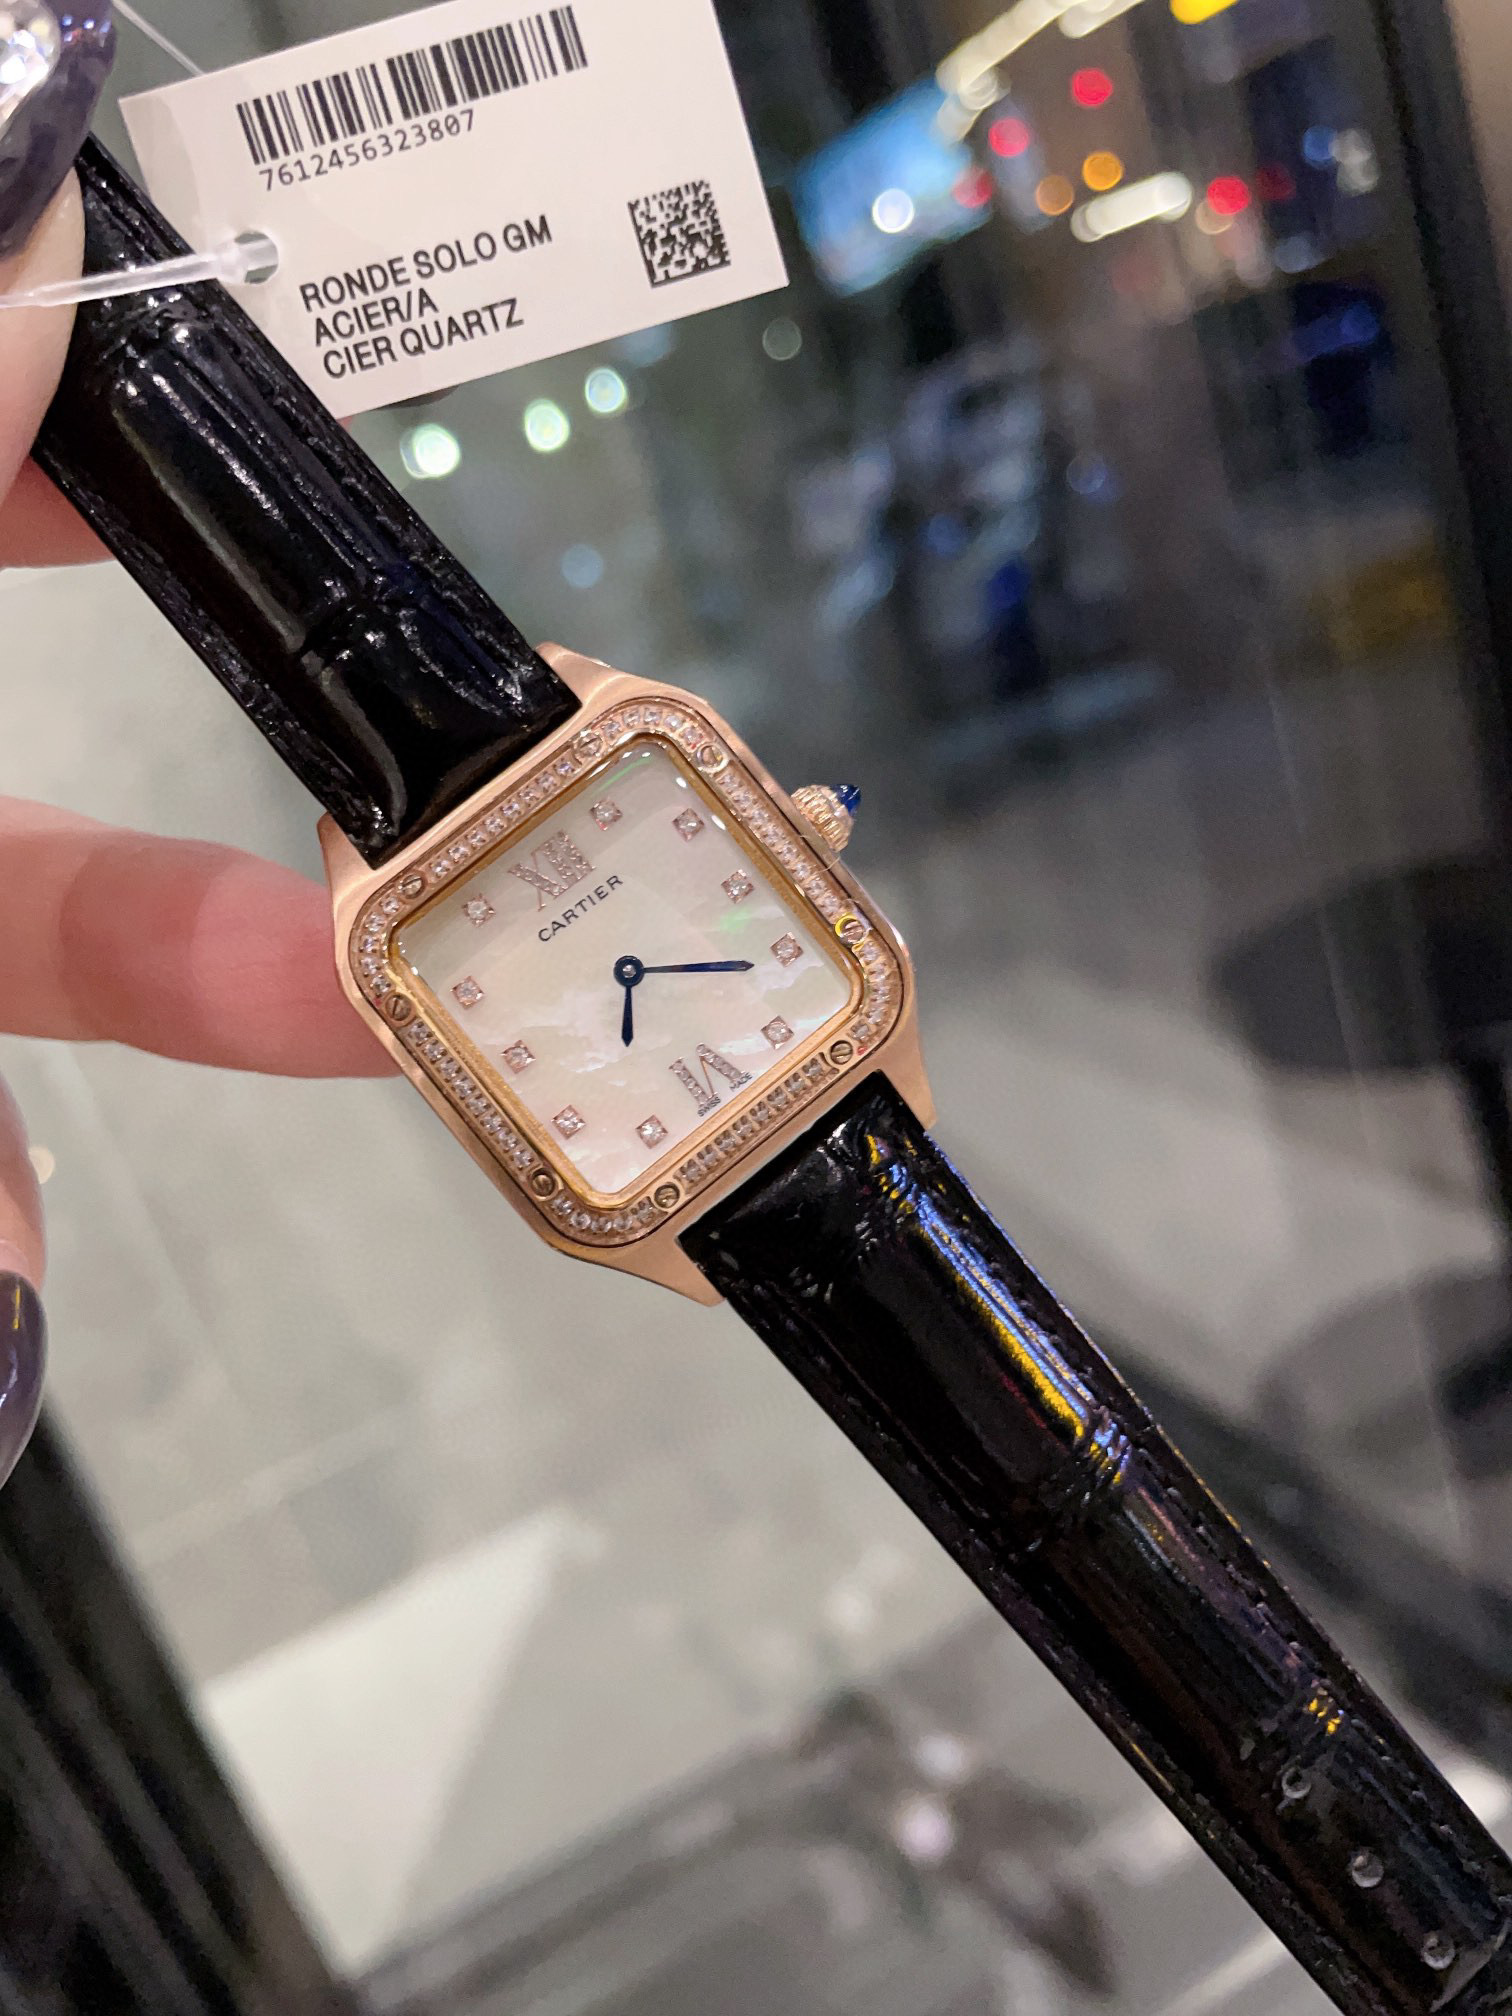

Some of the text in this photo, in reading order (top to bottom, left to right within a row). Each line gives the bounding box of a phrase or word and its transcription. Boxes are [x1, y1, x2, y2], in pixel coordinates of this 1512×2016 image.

[259, 109, 474, 190] 7612456323807
[300, 215, 552, 312] RONDE SOLO GM
[315, 288, 438, 346] ACIER/A
[323, 298, 524, 379] CIER QUARTZ
[538, 875, 623, 942] CARTIER
[697, 1072, 752, 1117] SWISS MADE
